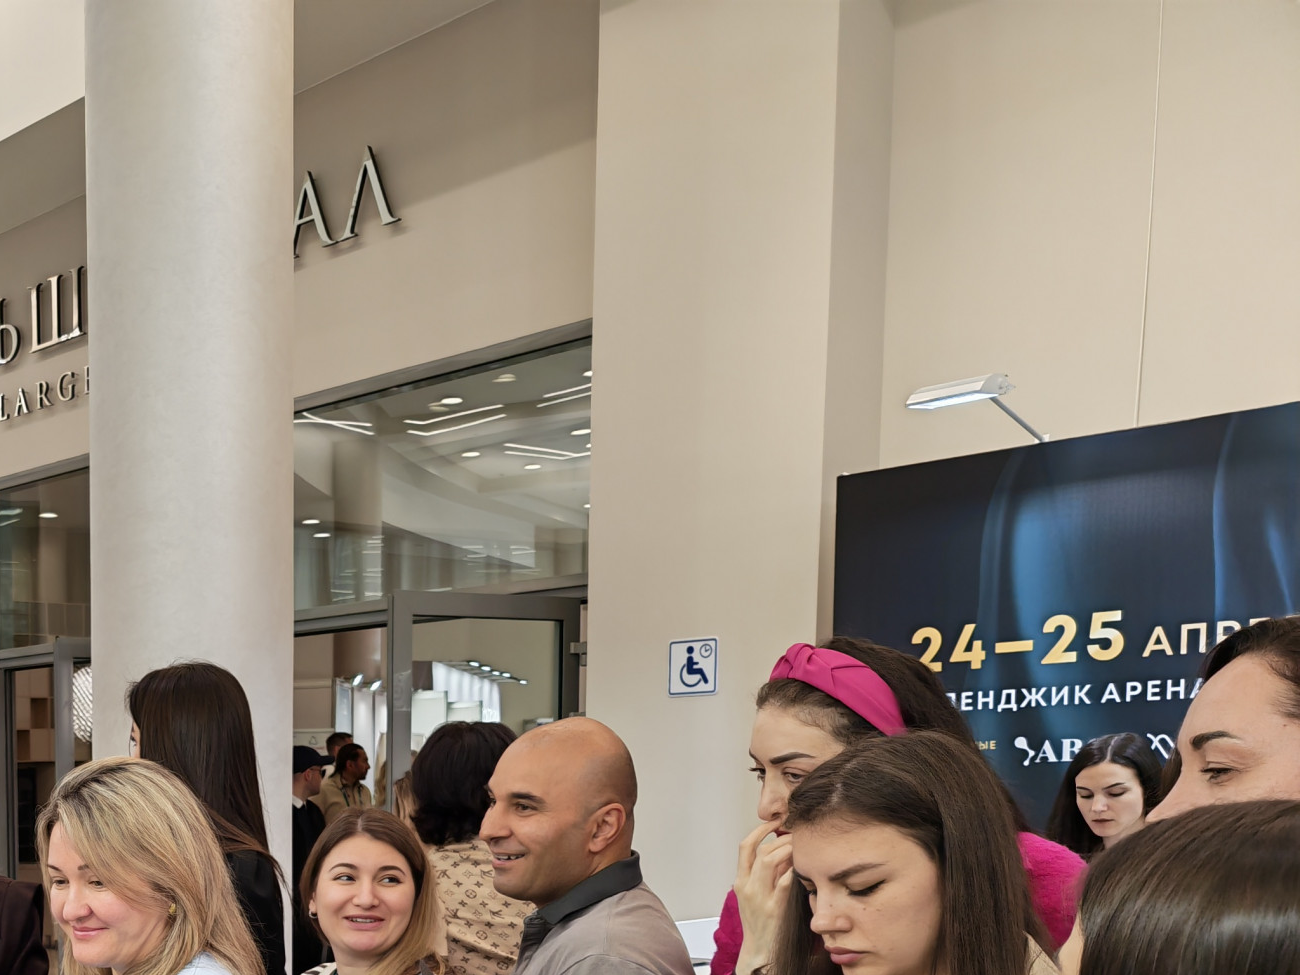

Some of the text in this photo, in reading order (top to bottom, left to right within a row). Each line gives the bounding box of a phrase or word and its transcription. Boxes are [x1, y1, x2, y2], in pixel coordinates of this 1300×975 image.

[293, 145, 402, 259] АЛ
[946, 684, 1092, 713] ЛЕНДЖИК
[1034, 738, 1083, 763] AB
